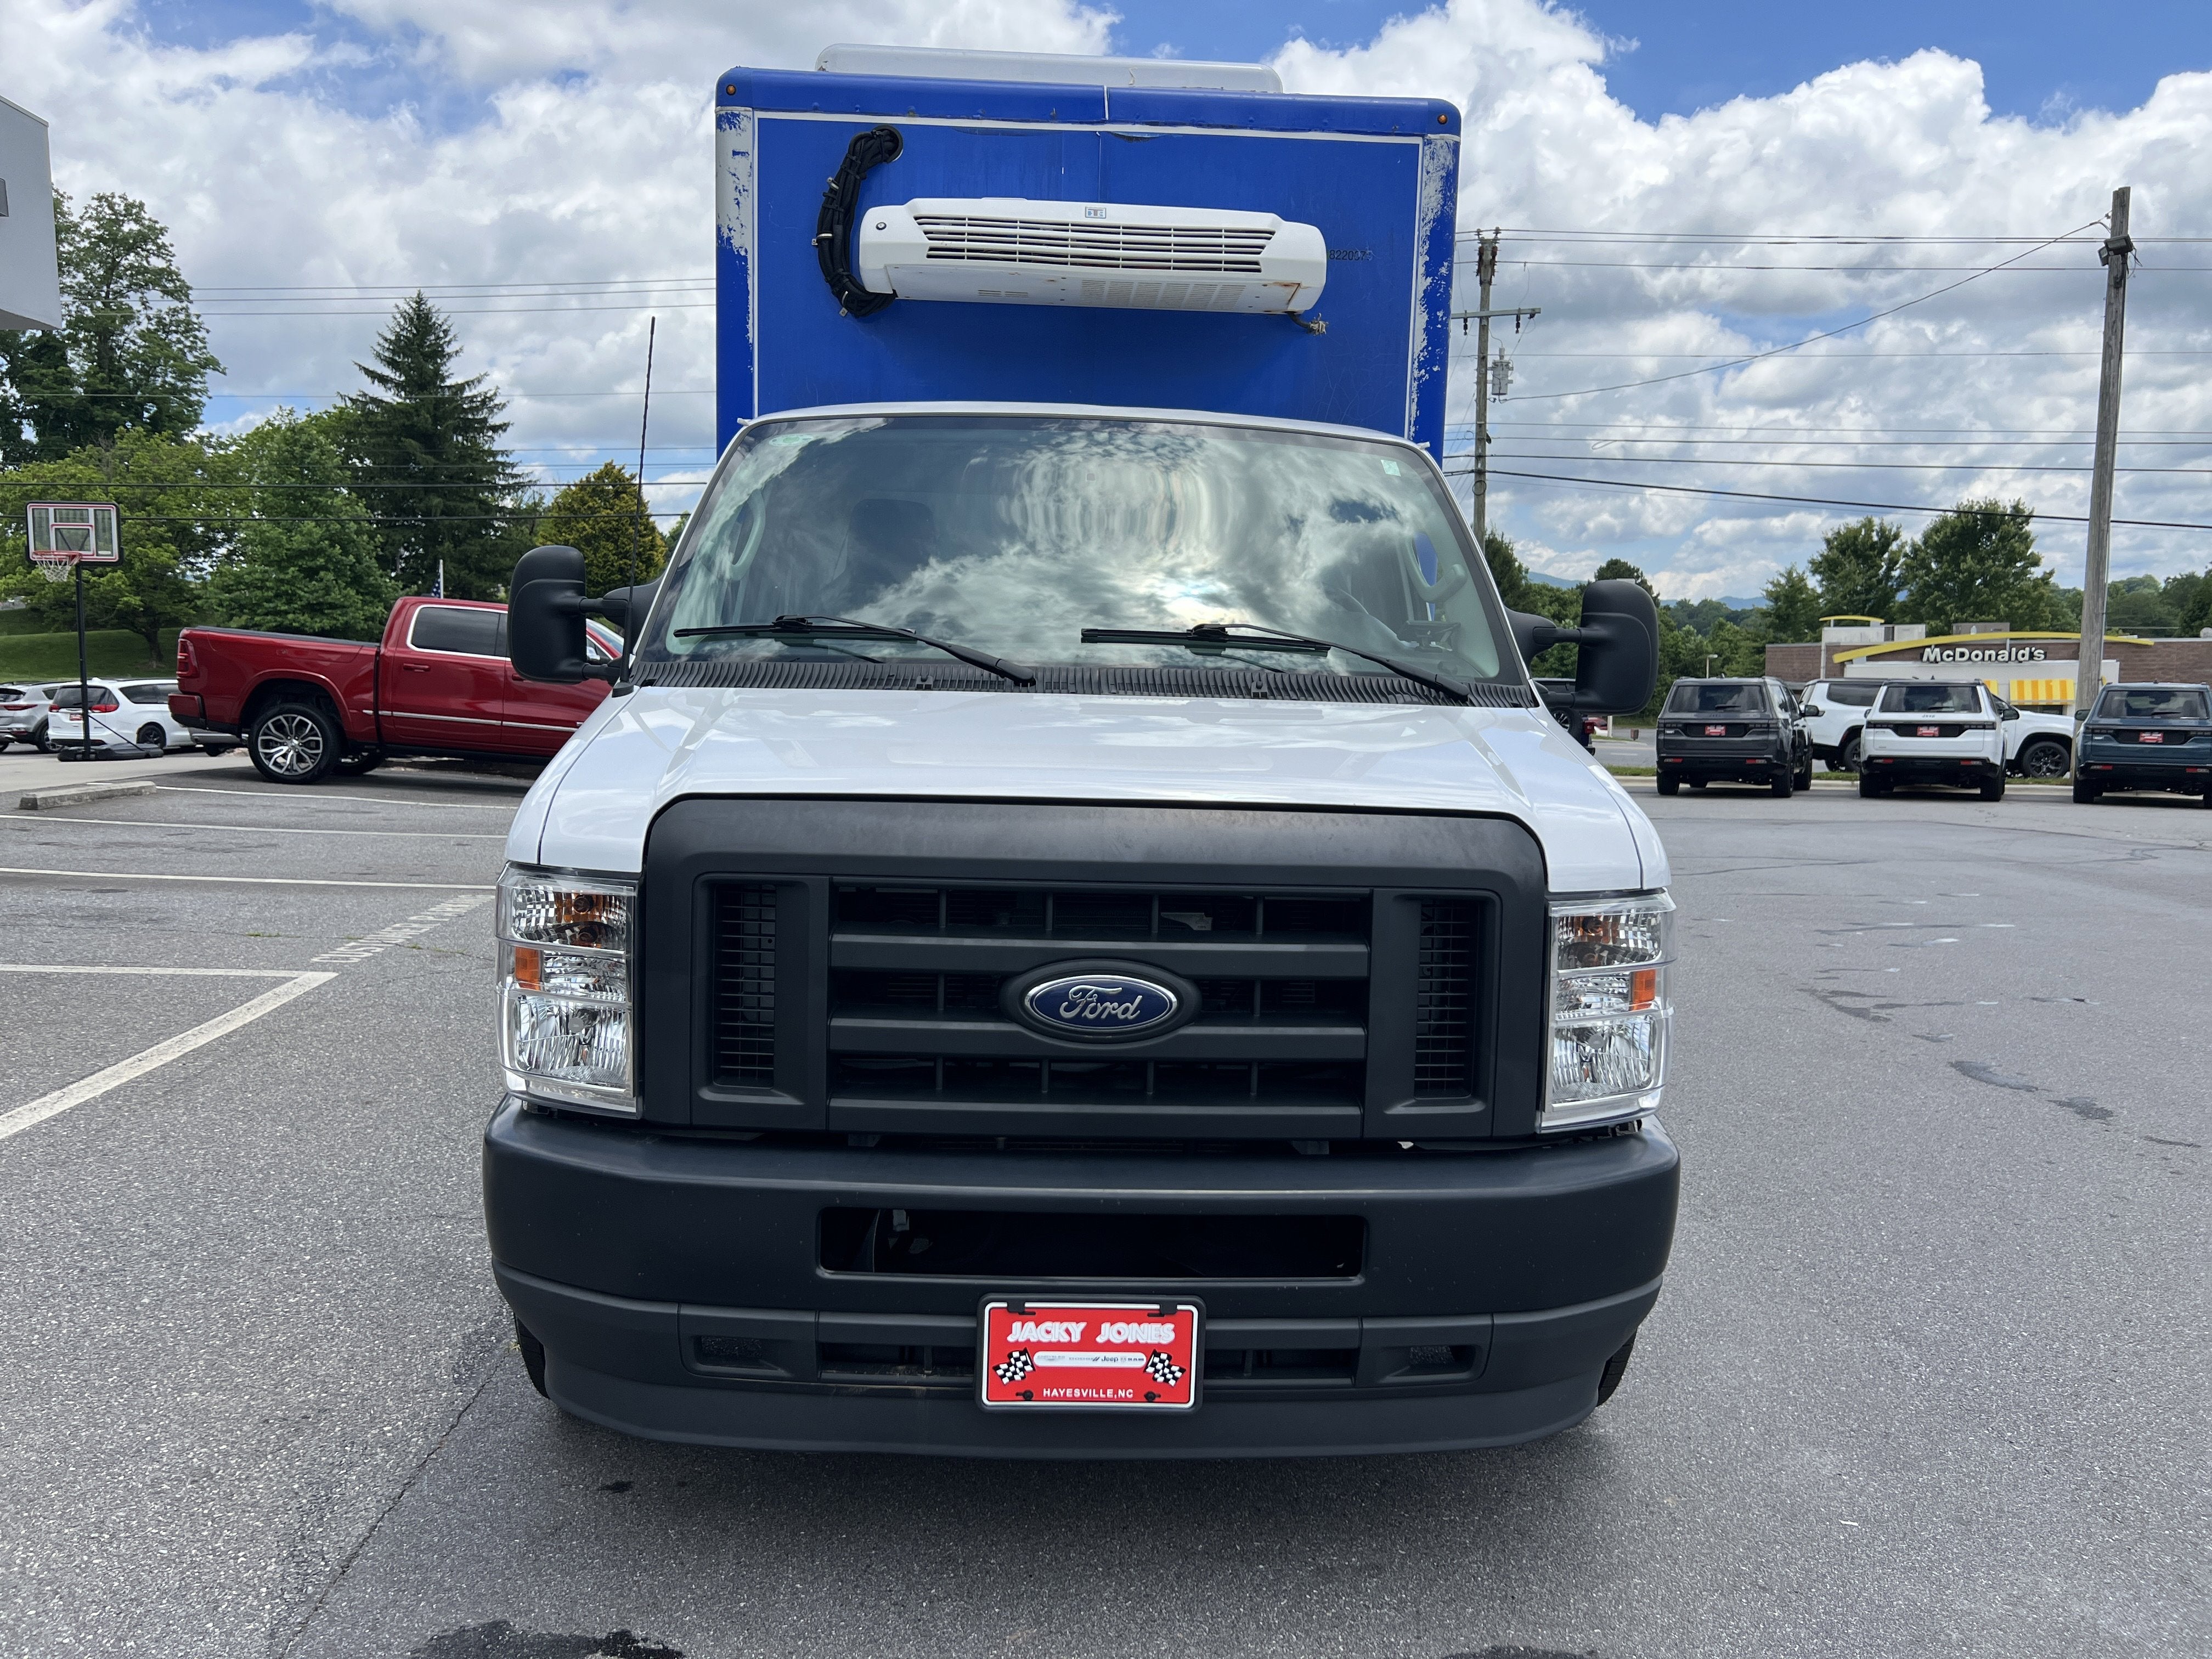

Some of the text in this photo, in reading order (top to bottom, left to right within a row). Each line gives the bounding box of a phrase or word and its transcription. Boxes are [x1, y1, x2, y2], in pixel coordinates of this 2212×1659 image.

[1329, 250, 1373, 261] 822007
[1922, 647, 2045, 663] McDonald's
[1059, 985, 1143, 1019] Ford
[1006, 1321, 1176, 1344] JACKY JONES
[1043, 1388, 1133, 1398] HAYESVILLE,NC
